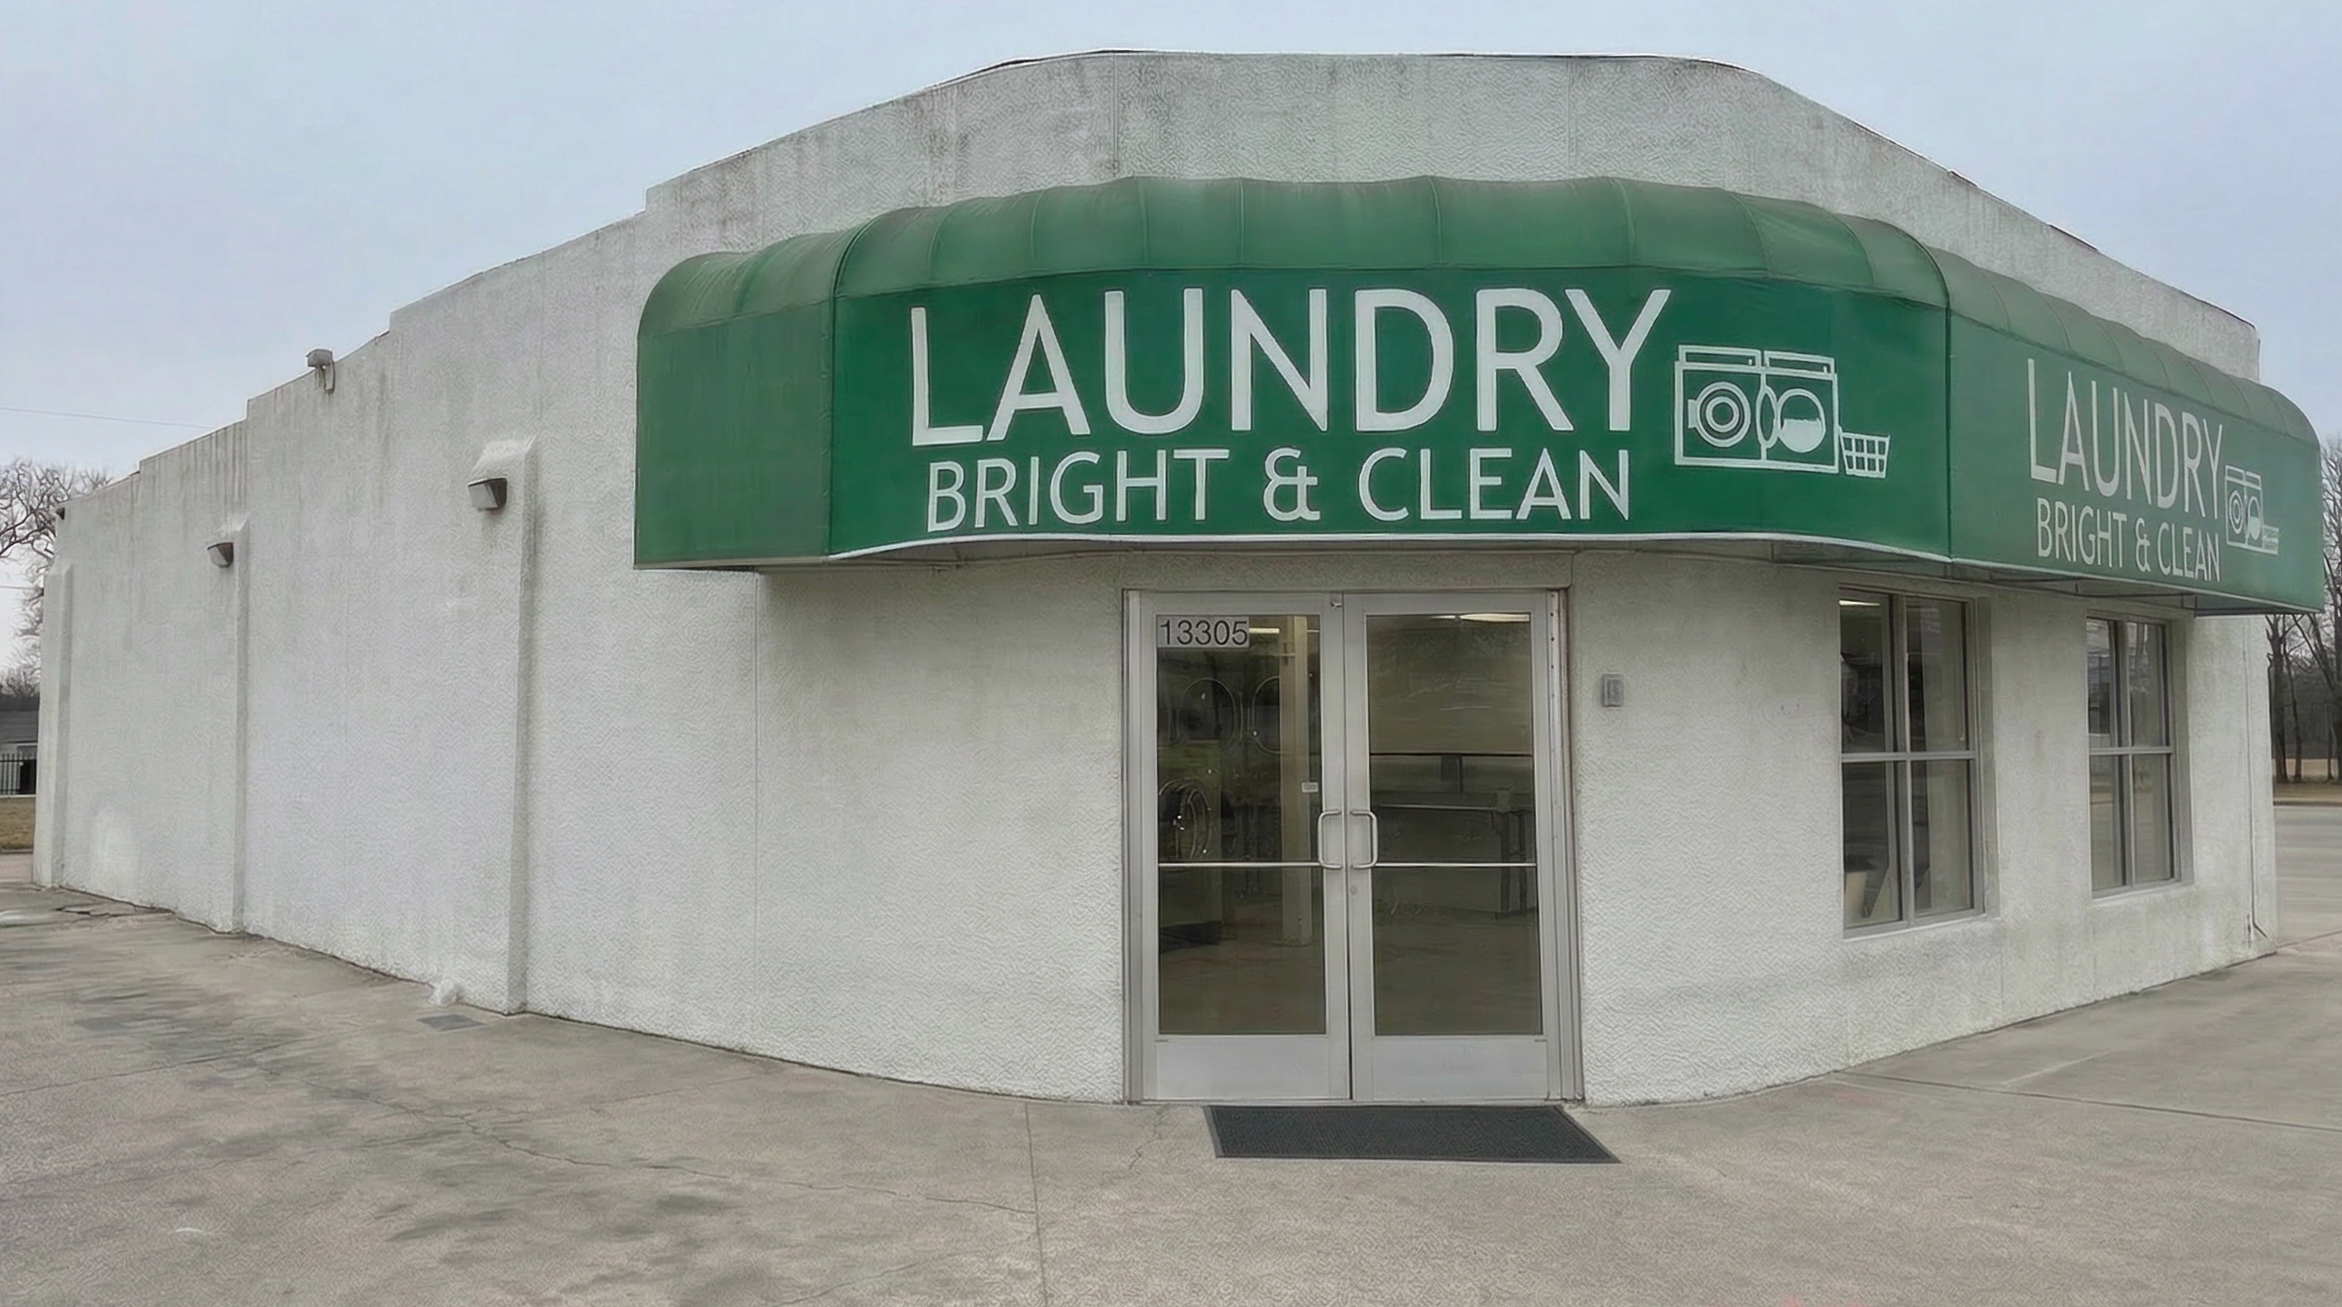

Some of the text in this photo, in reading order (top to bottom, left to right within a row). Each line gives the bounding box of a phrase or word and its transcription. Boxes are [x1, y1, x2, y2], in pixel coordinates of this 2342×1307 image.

[910, 287, 1671, 447] LAUNDRY
[2027, 357, 2223, 520] LAUNDRY
[926, 446, 1630, 533] BRIGHT & CLEAN
[2036, 496, 2221, 582] BRIGHT & CLEAN
[1159, 619, 1248, 645] 13305
